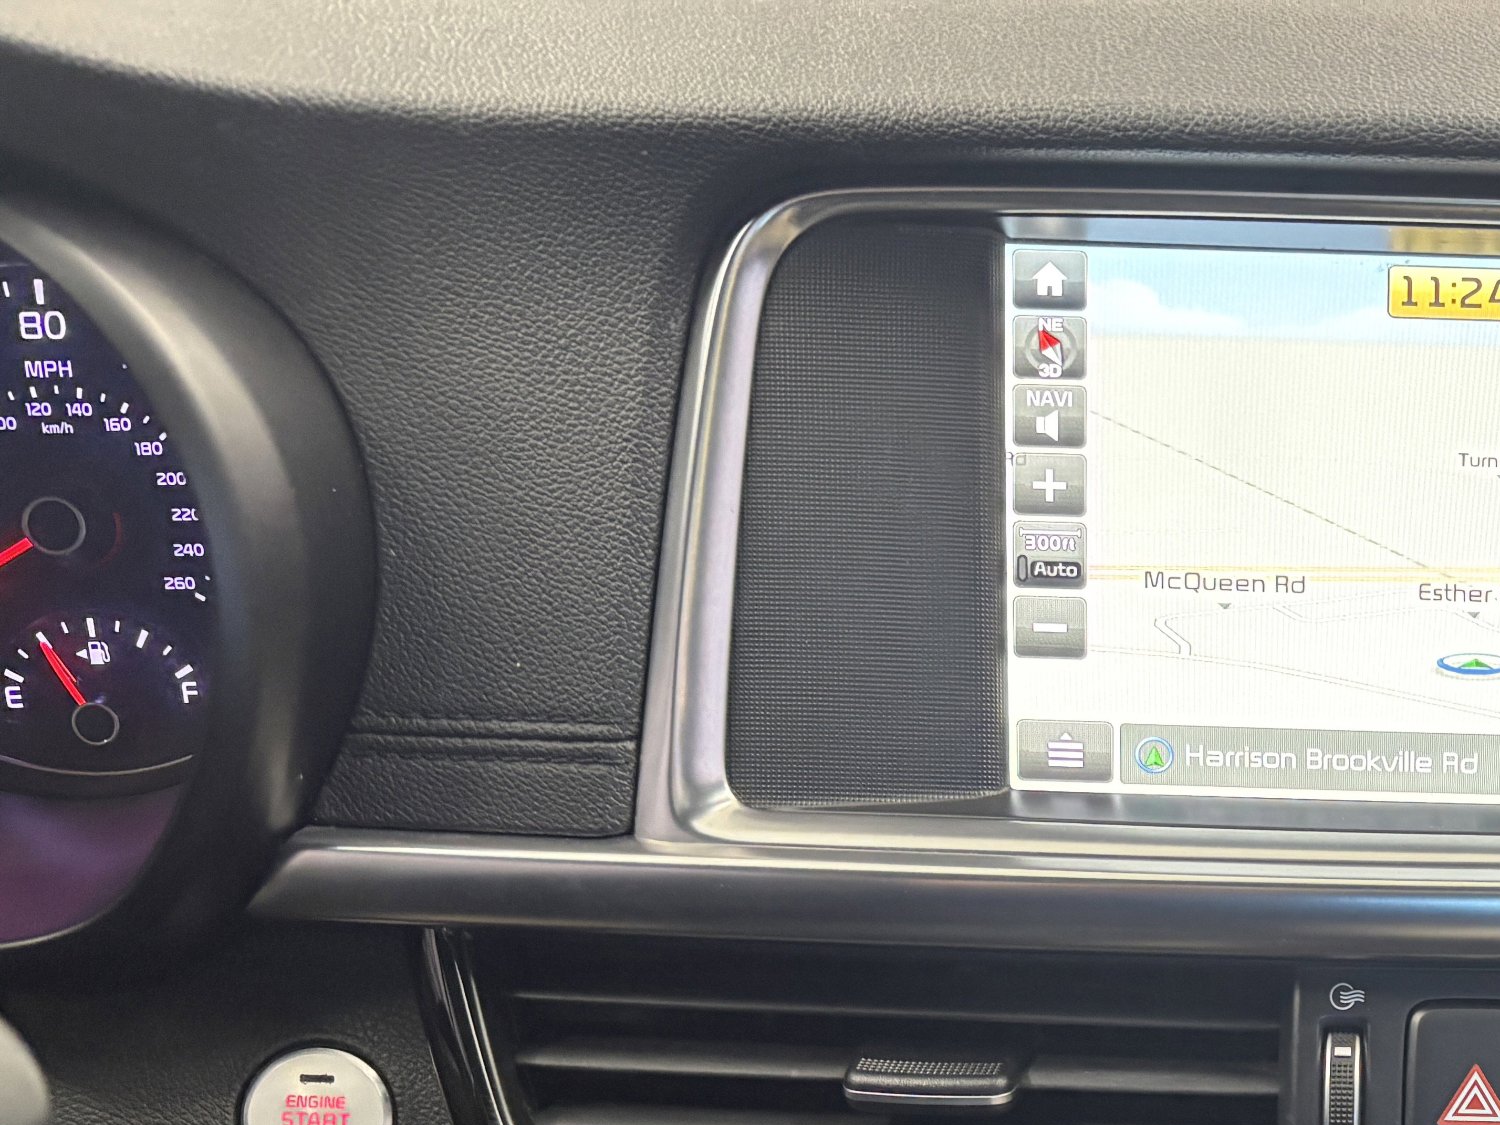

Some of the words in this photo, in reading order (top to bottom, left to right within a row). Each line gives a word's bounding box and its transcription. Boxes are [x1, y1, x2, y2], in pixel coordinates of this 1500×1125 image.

[18, 311, 66, 340] 80
[1038, 317, 1064, 332] NE
[24, 360, 73, 379] MPH
[1038, 363, 1062, 378] 3D
[1026, 390, 1073, 408] NAVI
[25, 402, 52, 417] 120
[65, 402, 93, 417] 140
[41, 421, 74, 435] km/h
[103, 417, 132, 432] 160
[134, 441, 163, 456] 180
[156, 472, 187, 486] 200
[173, 543, 205, 557] 240
[1034, 561, 1077, 577] Auto
[163, 576, 196, 591] 260
[1144, 571, 1265, 594] McQueen
[1275, 575, 1306, 594] Rd
[1418, 583, 1492, 604] Esther
[5, 685, 24, 708] E
[181, 681, 198, 703] F
[1186, 744, 1297, 768] Harrison
[1306, 749, 1432, 773] Brookville
[1443, 751, 1478, 773] Rd
[285, 1095, 346, 1109] ENGINE
